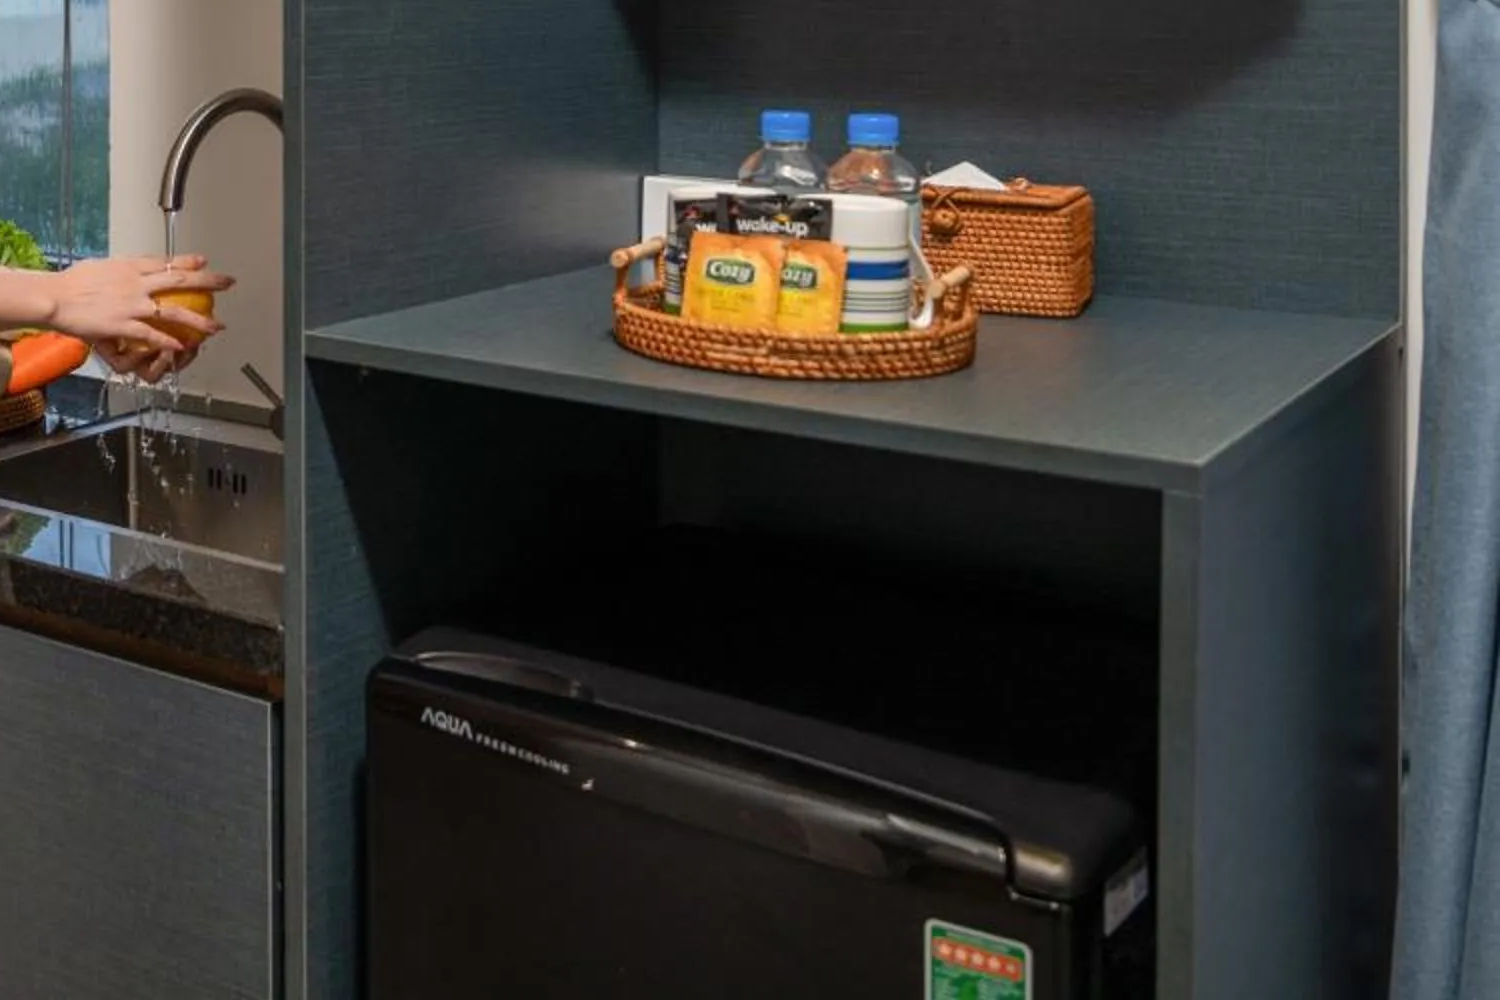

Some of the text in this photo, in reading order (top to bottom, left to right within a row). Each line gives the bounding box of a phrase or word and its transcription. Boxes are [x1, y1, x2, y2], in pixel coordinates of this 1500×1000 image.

[735, 216, 809, 239] wake-up
[709, 261, 750, 282] Cozy
[782, 268, 814, 287] ozy
[420, 706, 473, 741] AQUA
